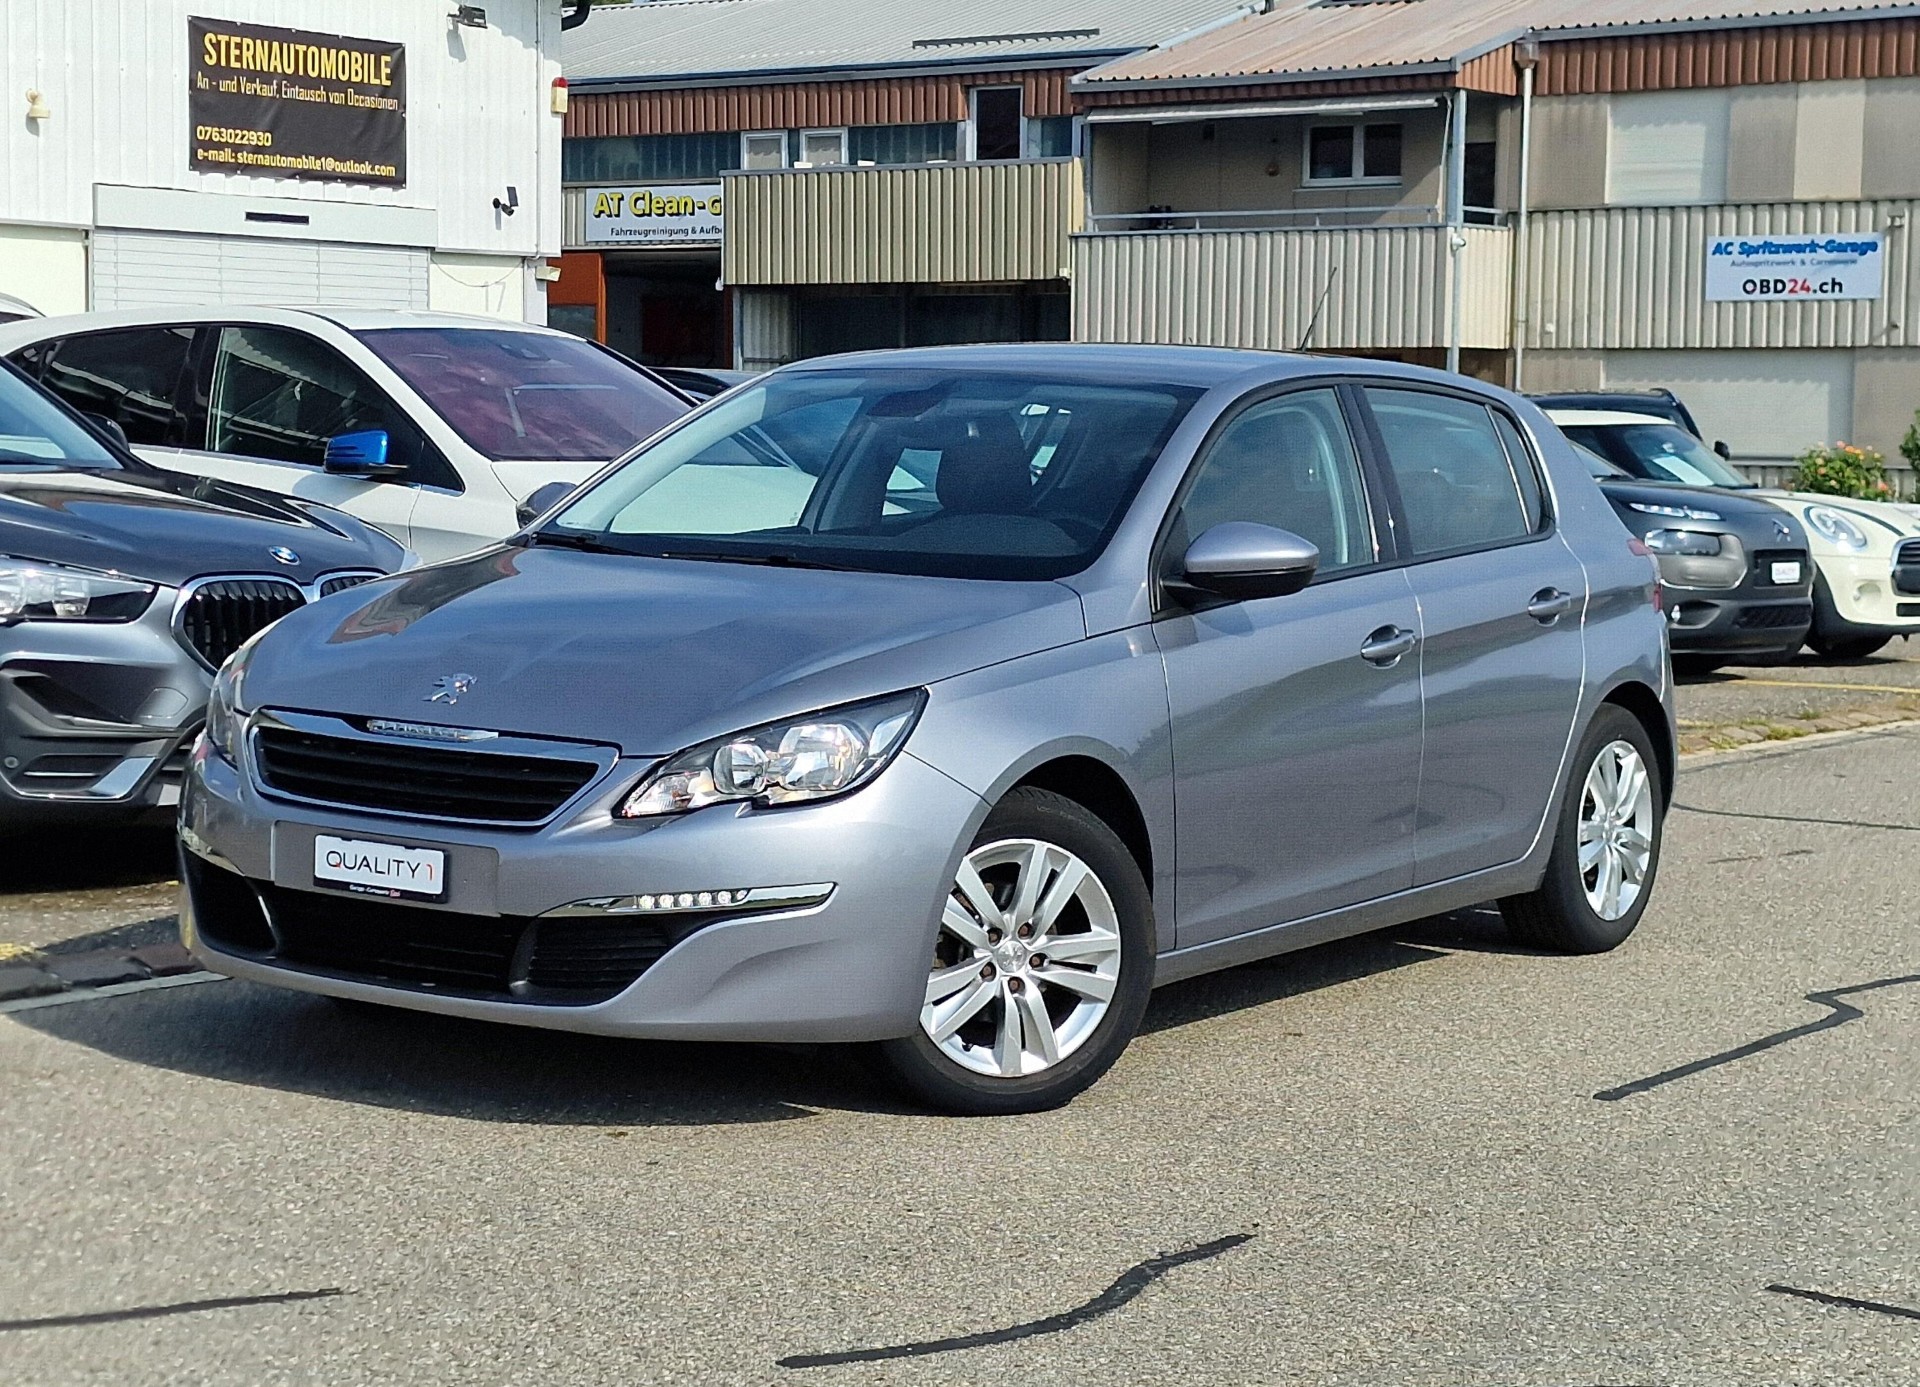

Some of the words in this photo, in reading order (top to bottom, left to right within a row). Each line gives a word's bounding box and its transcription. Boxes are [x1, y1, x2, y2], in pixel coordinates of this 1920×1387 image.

[203, 32, 392, 86] STERNAUTOMOBILE
[197, 70, 209, 90] An
[219, 75, 238, 93] und
[239, 76, 280, 99] Verkauf,
[281, 80, 327, 103] Eintausch
[328, 91, 345, 105] von
[347, 88, 398, 111] Occasionen
[196, 125, 272, 147] 0763022930
[197, 147, 236, 163] e-mail:
[237, 150, 396, 177] sternautomobile1@outlook.com
[593, 192, 624, 218] AT
[610, 224, 690, 238] Fahrzeugreinigung
[691, 226, 697, 235] &
[1712, 241, 1734, 256] AC
[1742, 277, 1844, 295] OBD24.ch
